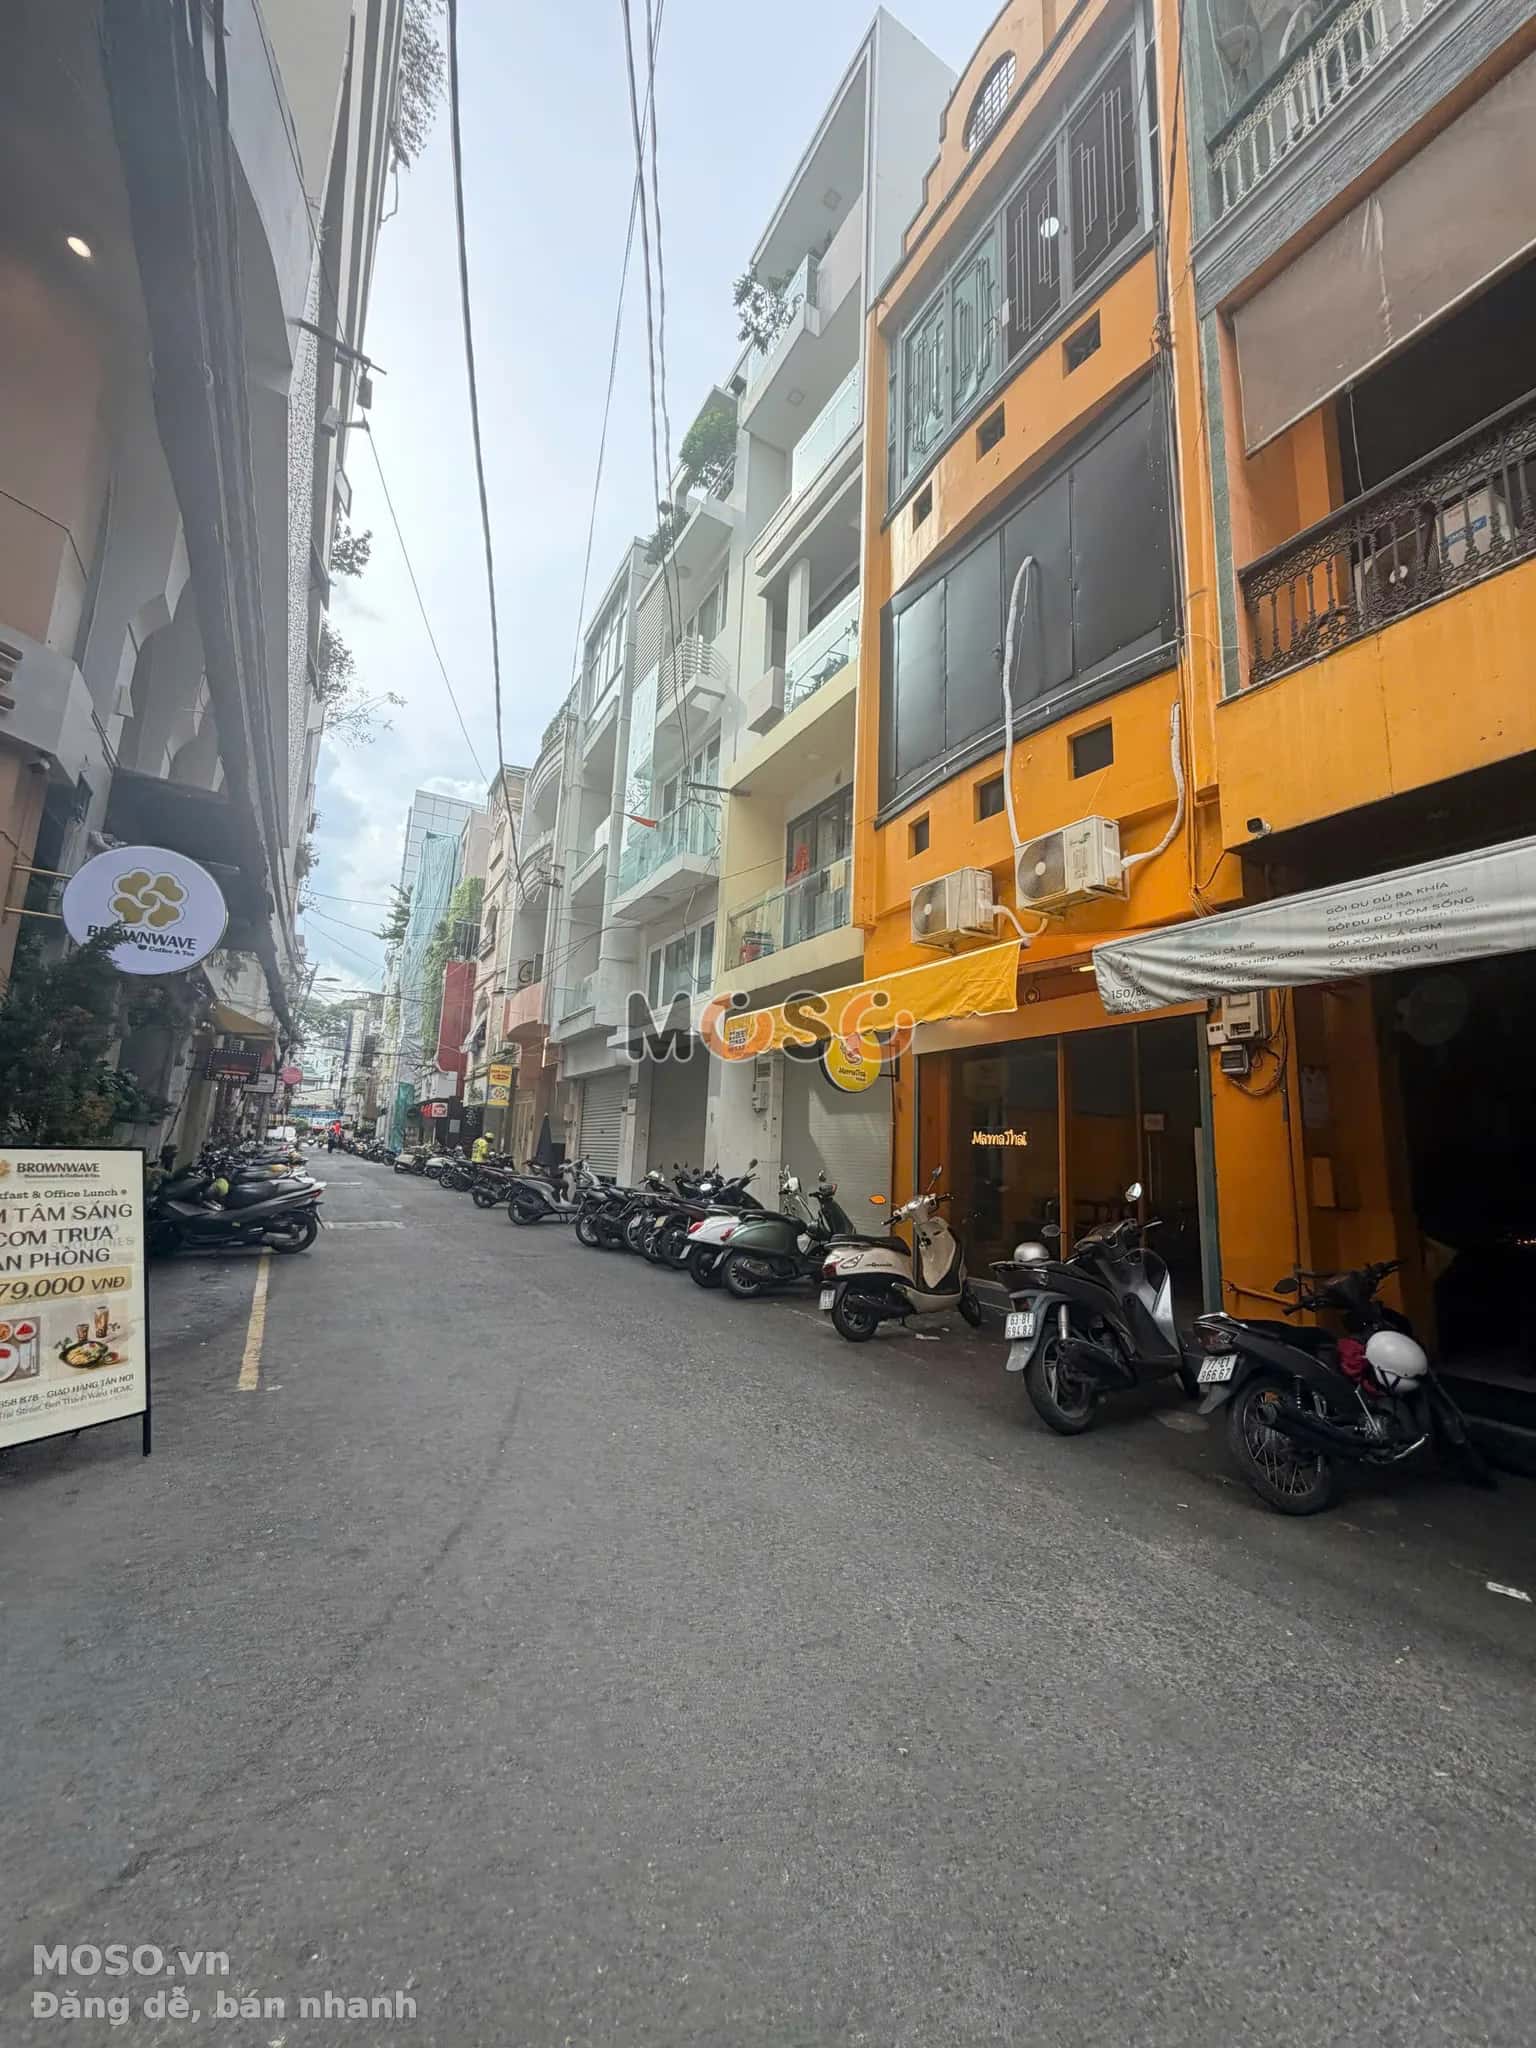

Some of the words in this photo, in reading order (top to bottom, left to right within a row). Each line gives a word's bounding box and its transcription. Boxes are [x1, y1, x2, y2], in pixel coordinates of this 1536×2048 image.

[16, 1162, 100, 1174] BROWNWAVE
[32, 1191, 41, 1200] &
[44, 1189, 80, 1199] Office
[83, 1188, 118, 1197] Lunch
[13, 1203, 65, 1223] TÂM
[72, 1200, 133, 1220] SÁNG
[53, 1225, 114, 1244] TRƯA
[30, 1246, 111, 1269] PHÒNG
[91, 1276, 126, 1290] VNĐ
